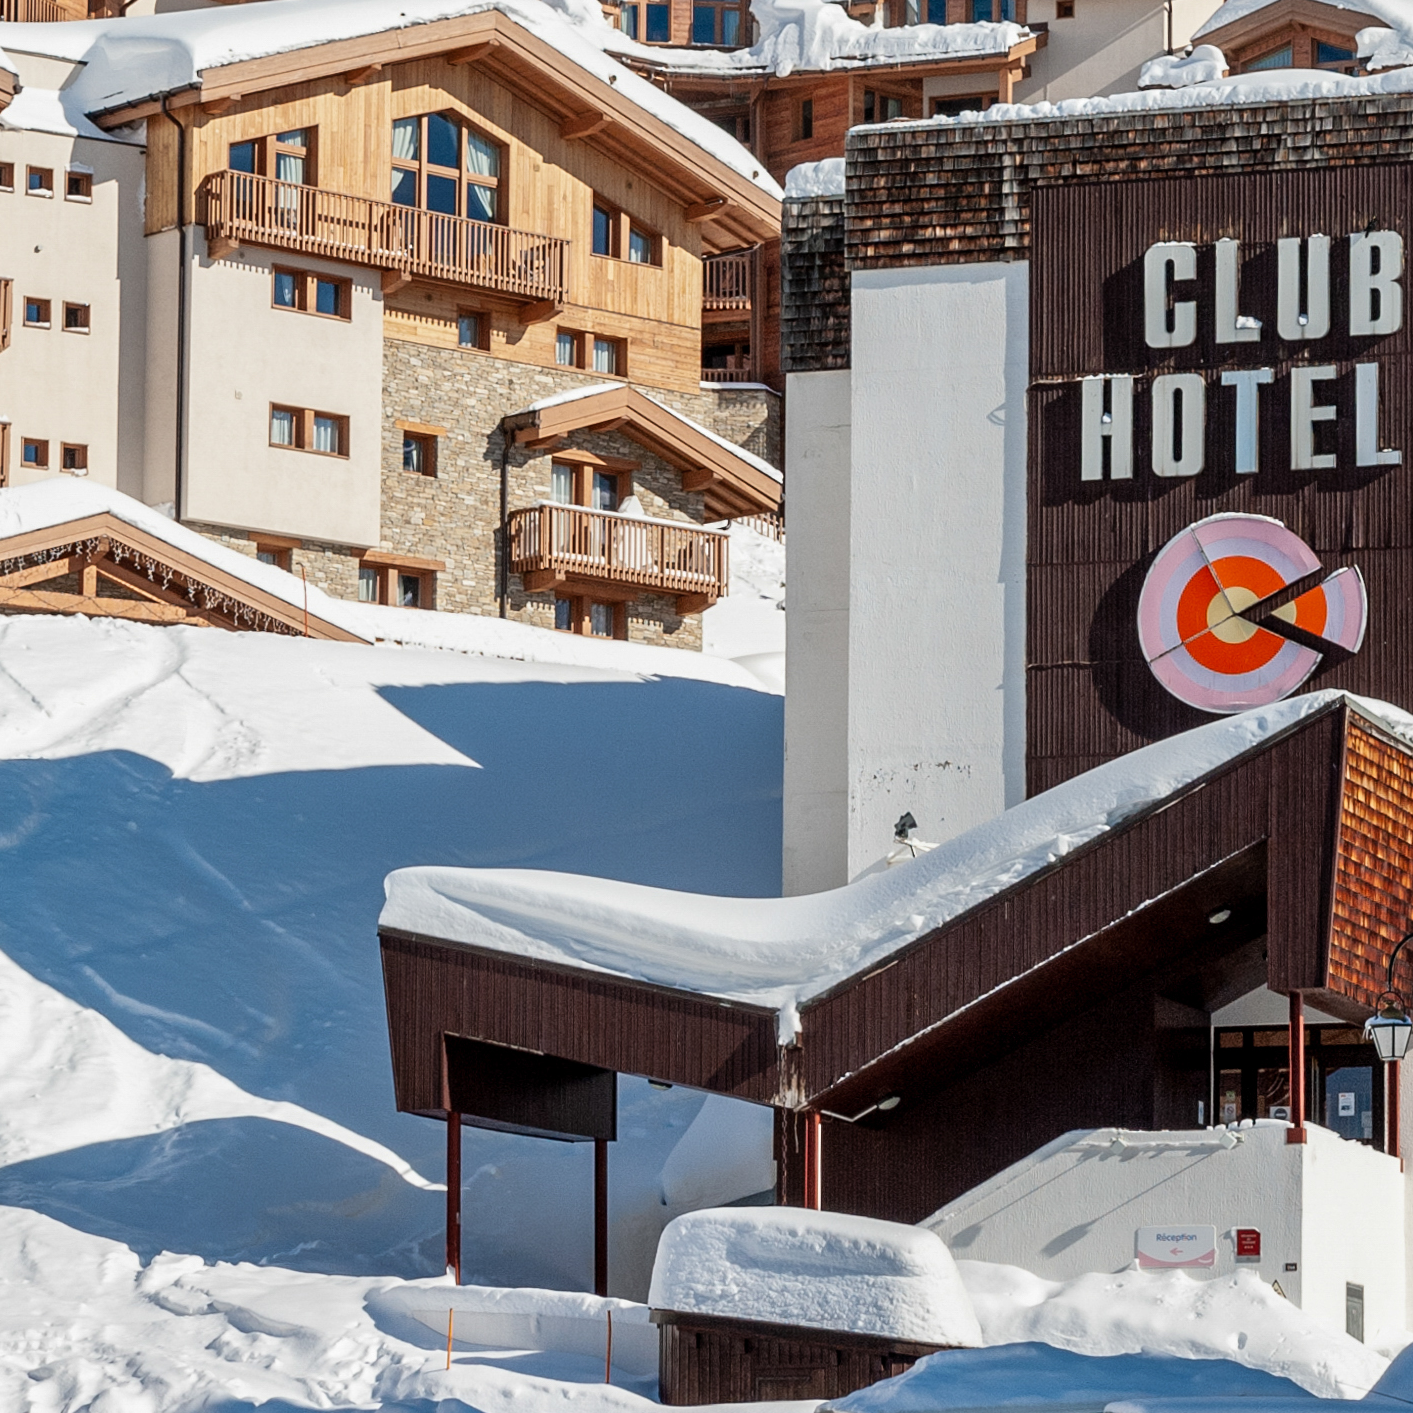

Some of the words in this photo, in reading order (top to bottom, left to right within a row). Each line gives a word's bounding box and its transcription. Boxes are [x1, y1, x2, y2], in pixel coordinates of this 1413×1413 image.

[1143, 230, 1406, 348] CLUB
[1080, 362, 1404, 482] HOTEL
[1156, 1233, 1197, 1243] Réception
